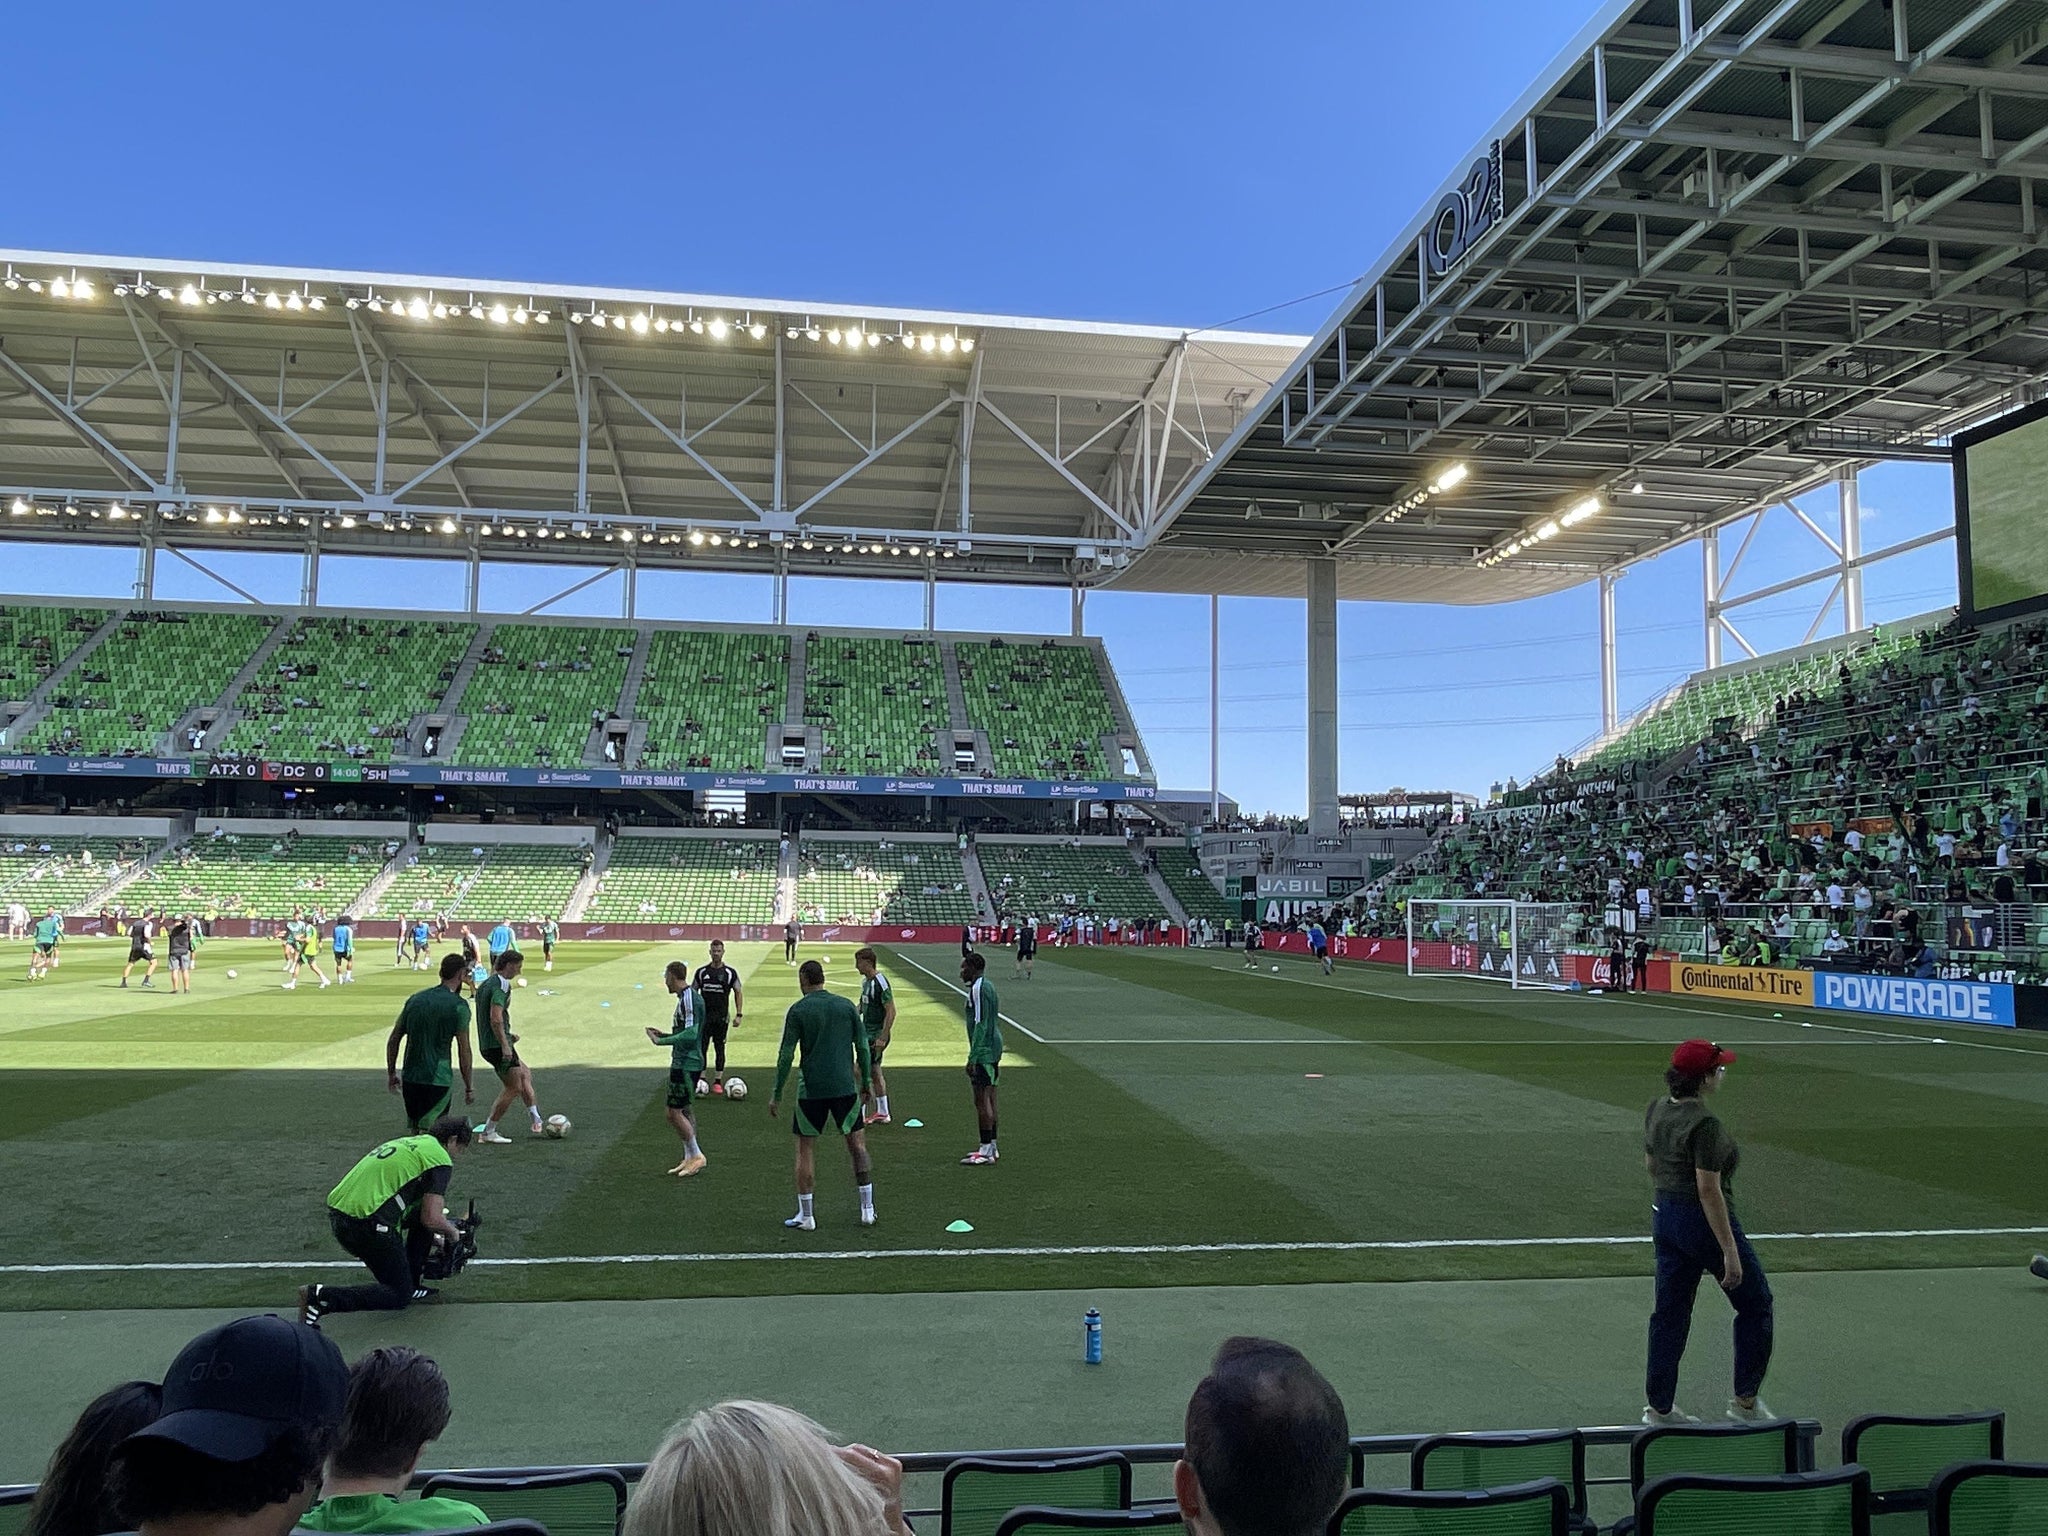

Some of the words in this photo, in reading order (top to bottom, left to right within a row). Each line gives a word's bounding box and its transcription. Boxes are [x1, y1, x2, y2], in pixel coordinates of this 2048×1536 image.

[155, 762, 191, 775] THAT'S
[209, 763, 241, 776] ATX
[246, 765, 257, 777] 0
[283, 764, 306, 777] DC
[314, 766, 325, 778] 0
[332, 767, 359, 777] 14:00
[439, 770, 474, 782] THAT'S
[474, 771, 510, 783] SMART.
[619, 774, 653, 786] THAT'S
[653, 775, 688, 787] SMART.
[793, 778, 826, 790] THAT'S
[826, 780, 860, 791] SMART.
[961, 783, 993, 795] THAT'S
[993, 784, 1026, 796] SMART.
[1576, 779, 1617, 797] ANTHEM
[1124, 786, 1155, 798] THAT'S
[1317, 839, 1343, 847] JABIL
[1296, 861, 1323, 869] JABIL
[1259, 879, 1325, 893] JABIL
[1680, 966, 1756, 992] Continental
[1766, 972, 1804, 996] Tire
[1823, 975, 1995, 1022] POWERADE
[189, 1351, 235, 1382] alo
